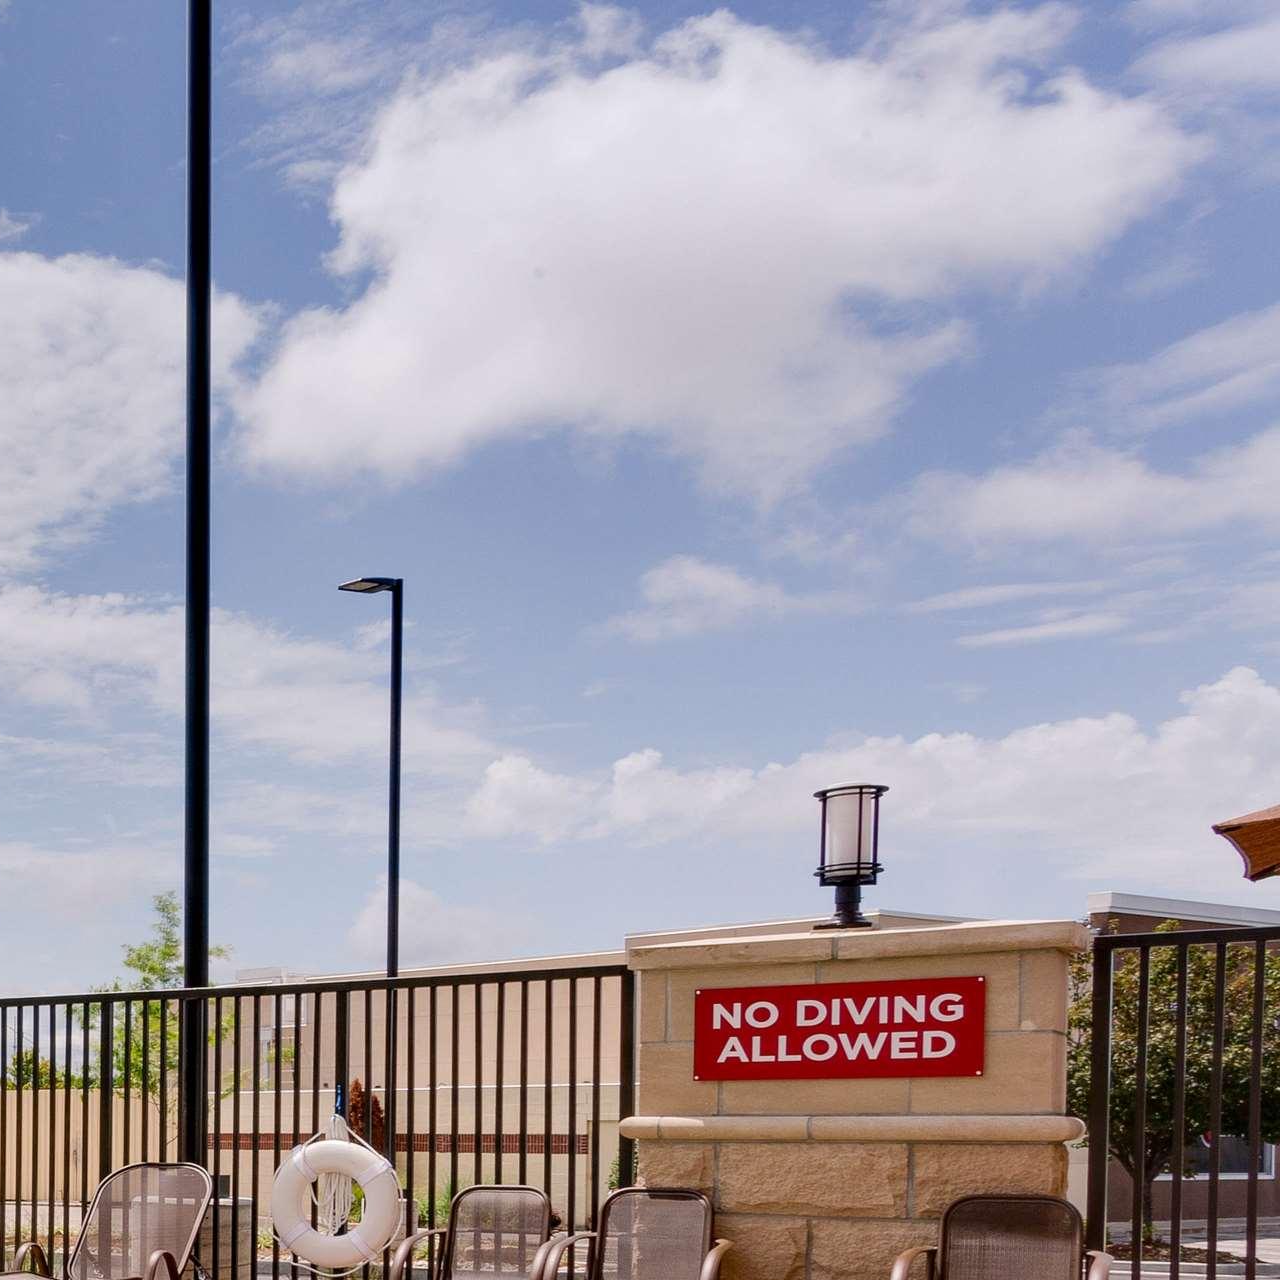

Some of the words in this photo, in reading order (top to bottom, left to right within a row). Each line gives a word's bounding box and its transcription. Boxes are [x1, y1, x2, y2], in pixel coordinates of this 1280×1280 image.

[712, 1001, 779, 1030] NO
[796, 993, 965, 1028] DIVING
[716, 1030, 957, 1064] ALLOWED
